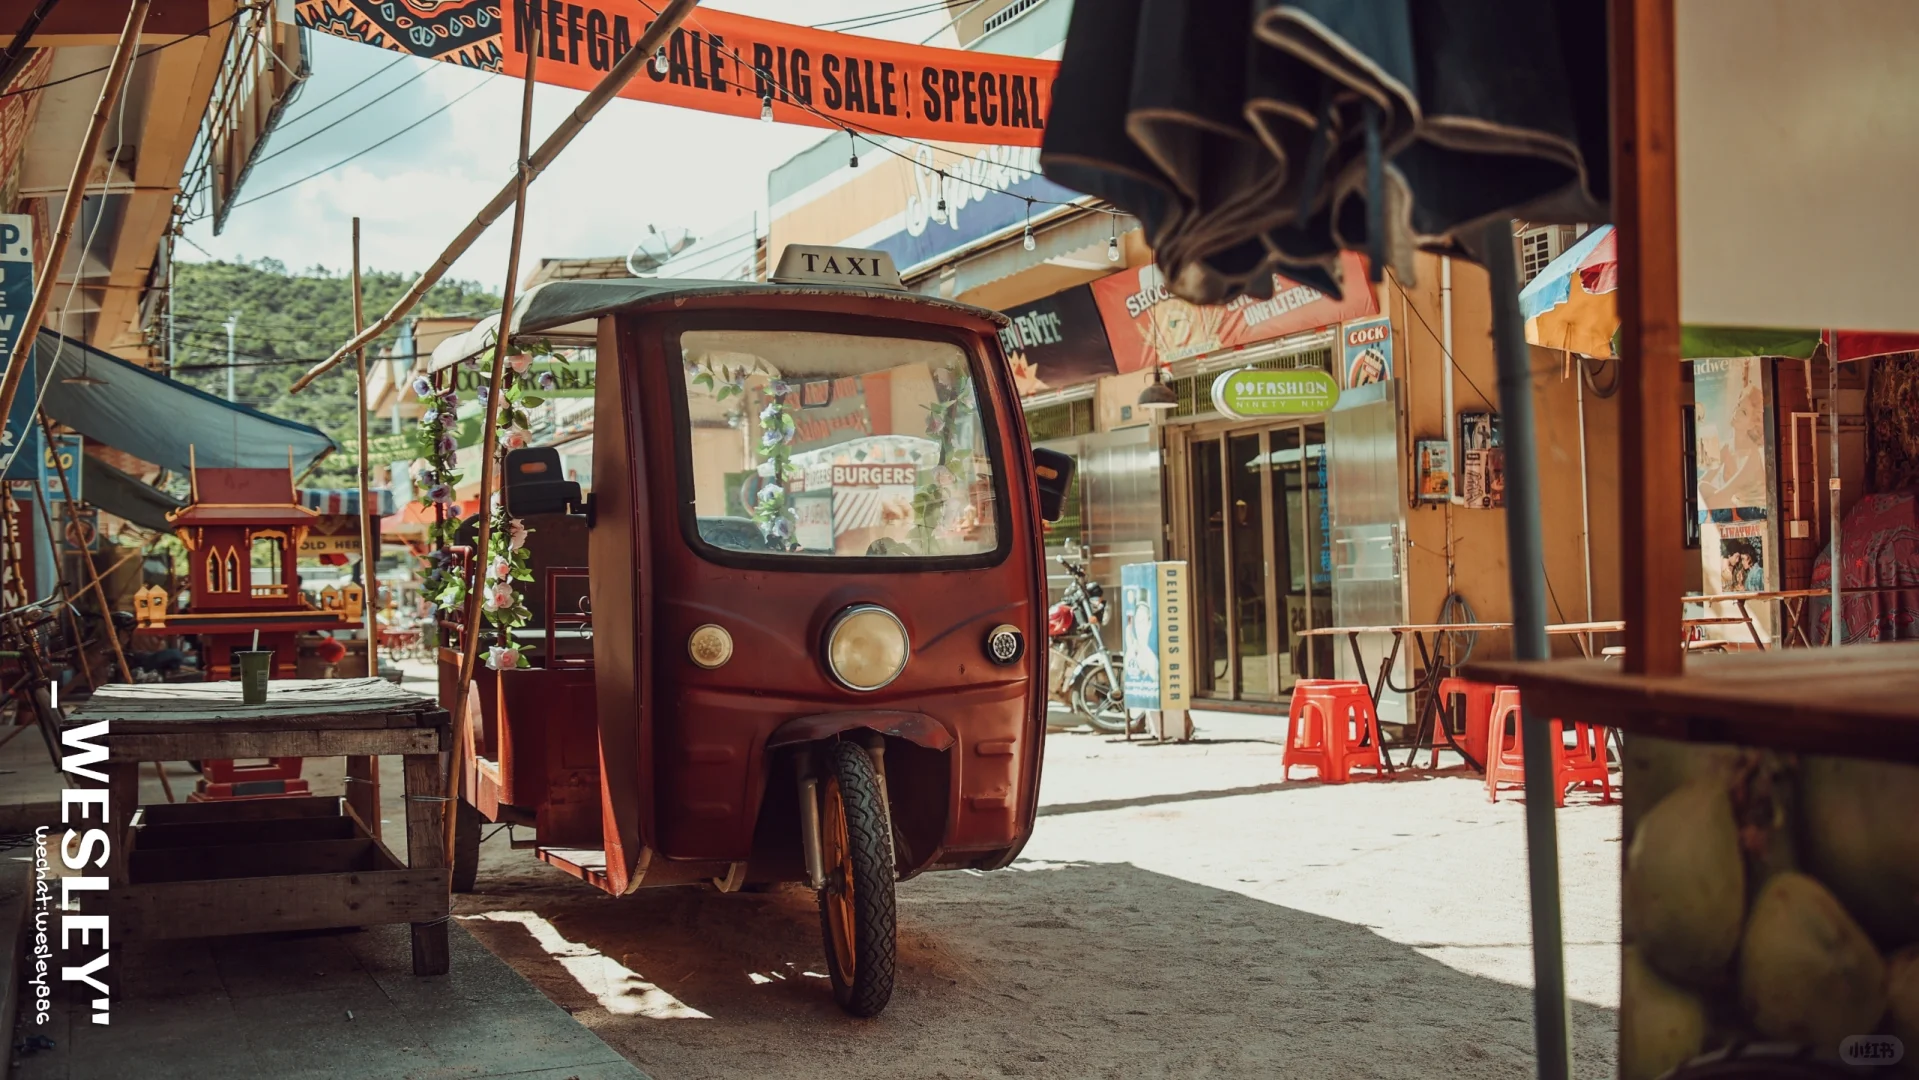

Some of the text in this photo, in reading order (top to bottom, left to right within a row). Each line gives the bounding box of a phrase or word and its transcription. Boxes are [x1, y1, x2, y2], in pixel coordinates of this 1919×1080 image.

[513, 0, 632, 73] MEFGA
[754, 42, 812, 106] BIG
[921, 66, 1044, 130] SPECIAL
[800, 252, 882, 277] TAXI
[1125, 282, 1175, 318] SHOC
[1349, 327, 1384, 345] COCK
[1236, 400, 1287, 409] NINETY
[833, 467, 915, 484] BURGERS
[1166, 569, 1181, 701] DELICIOUS BEER
